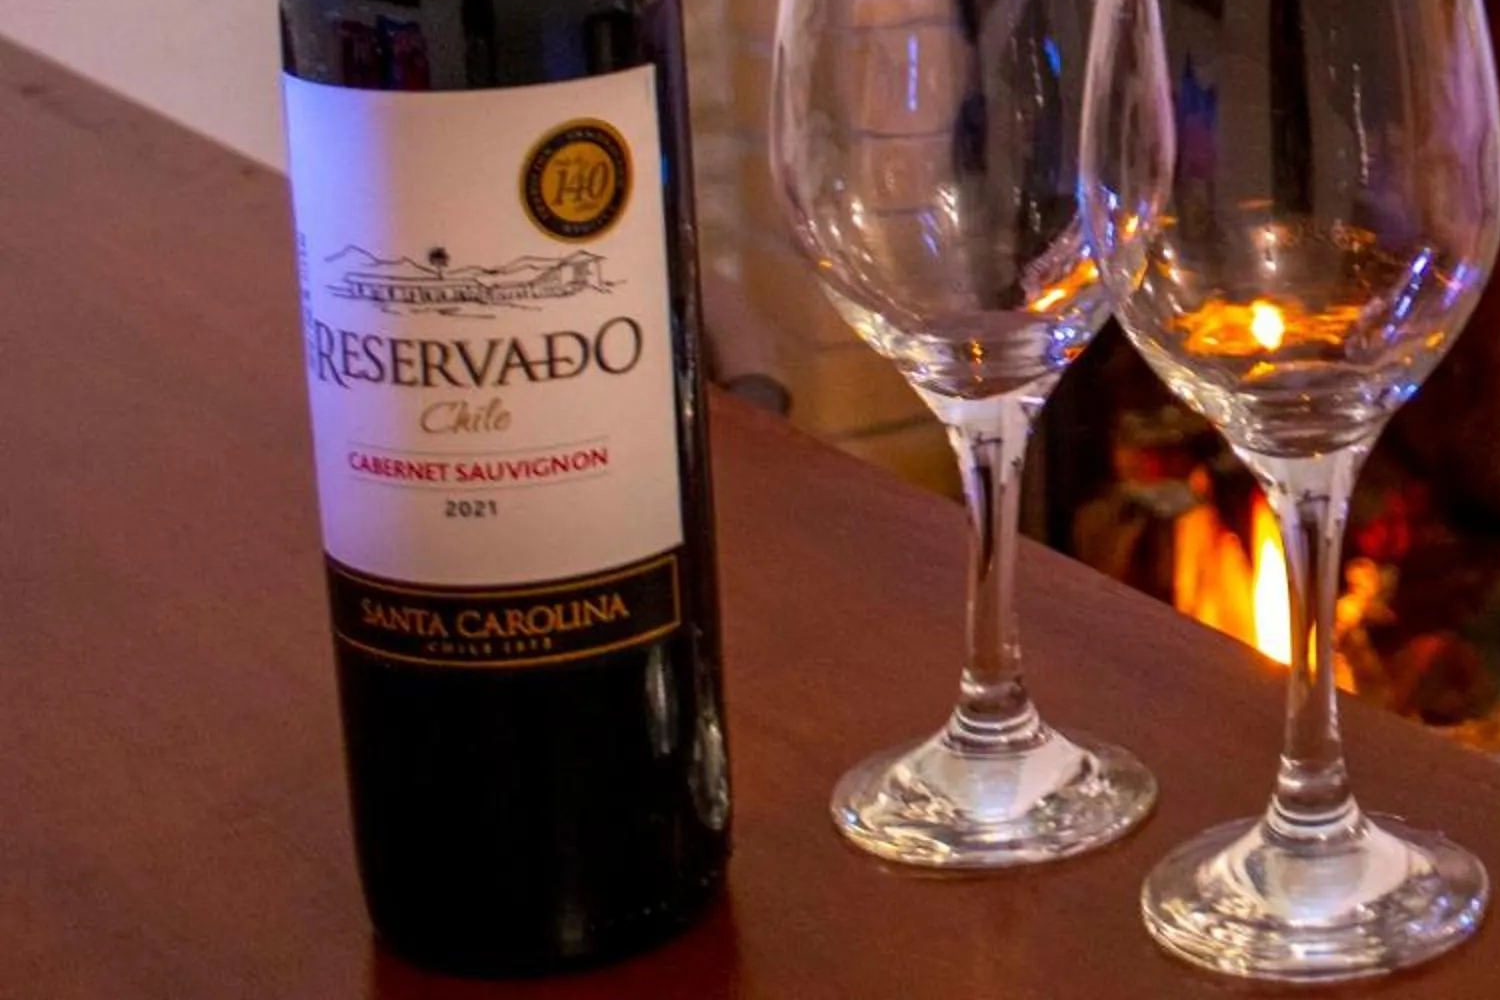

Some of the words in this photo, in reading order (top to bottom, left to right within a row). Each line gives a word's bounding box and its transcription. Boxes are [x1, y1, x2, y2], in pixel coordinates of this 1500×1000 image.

[551, 161, 609, 206] 140
[313, 316, 644, 389] RESERVADO
[420, 398, 512, 434] Chile
[350, 451, 450, 482] CABERNET
[456, 448, 608, 482] SAUVIGNON
[445, 500, 498, 518] 2021
[361, 598, 449, 637] SANTA
[456, 593, 630, 639] CAROLINA
